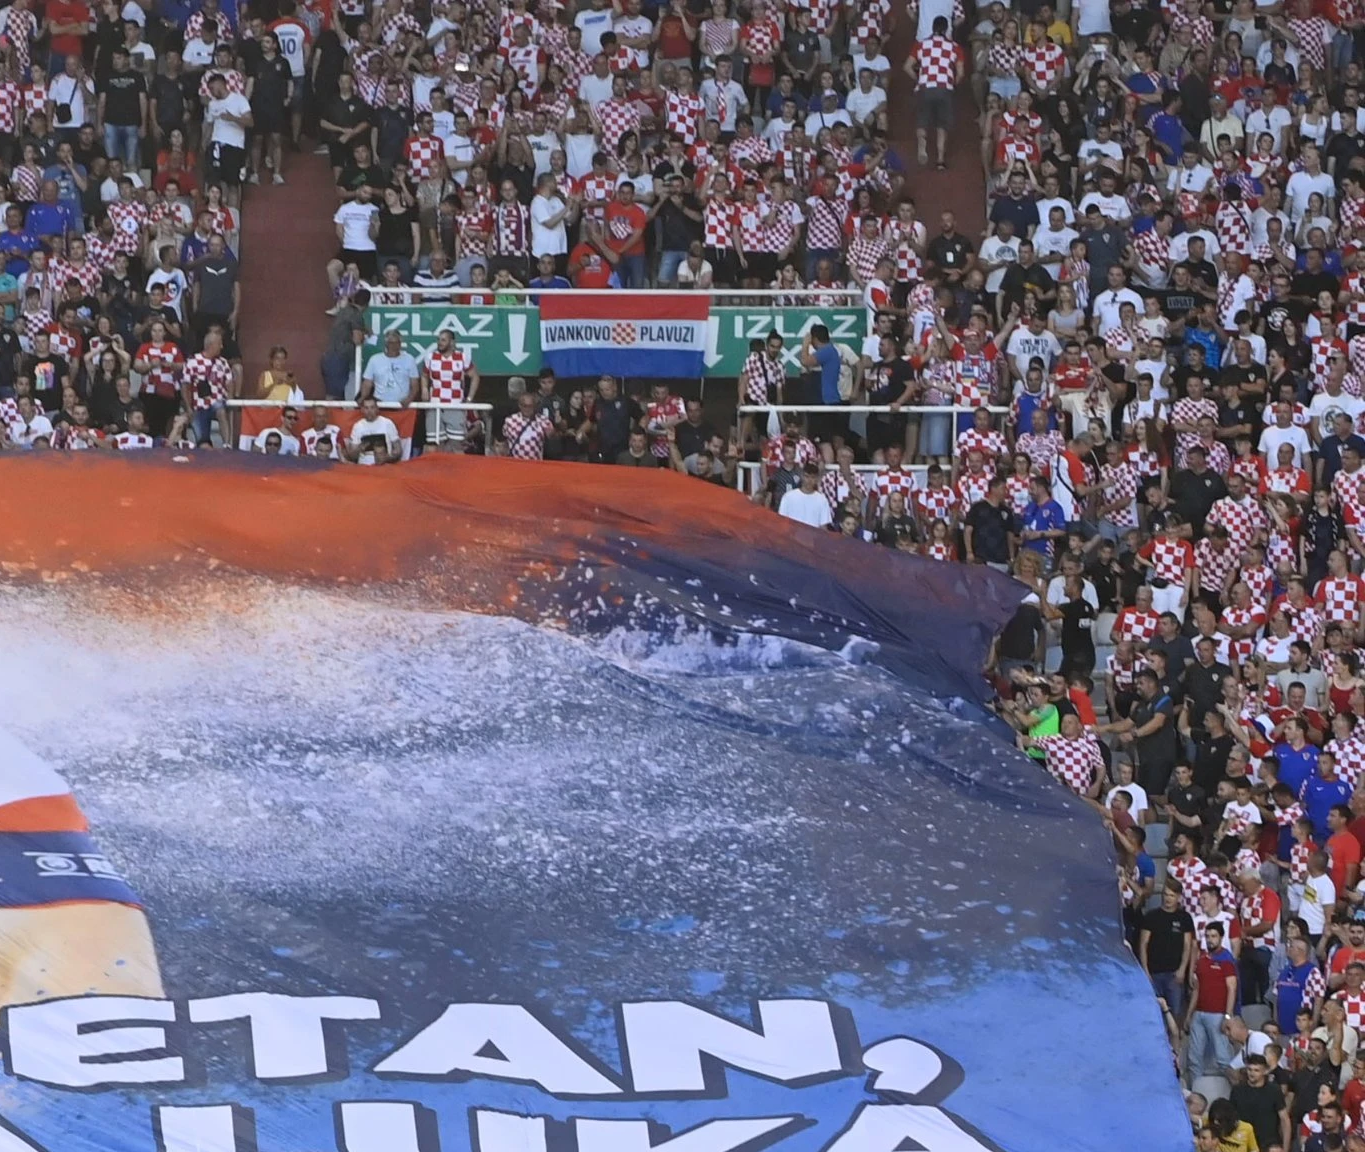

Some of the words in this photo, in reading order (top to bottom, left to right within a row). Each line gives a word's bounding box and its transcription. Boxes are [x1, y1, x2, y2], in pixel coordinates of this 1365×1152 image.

[371, 313, 494, 337] IZLAZ
[544, 322, 611, 344] IVANKOVO
[640, 325, 694, 344] PLAVUZI
[734, 315, 858, 338] IZLAZ
